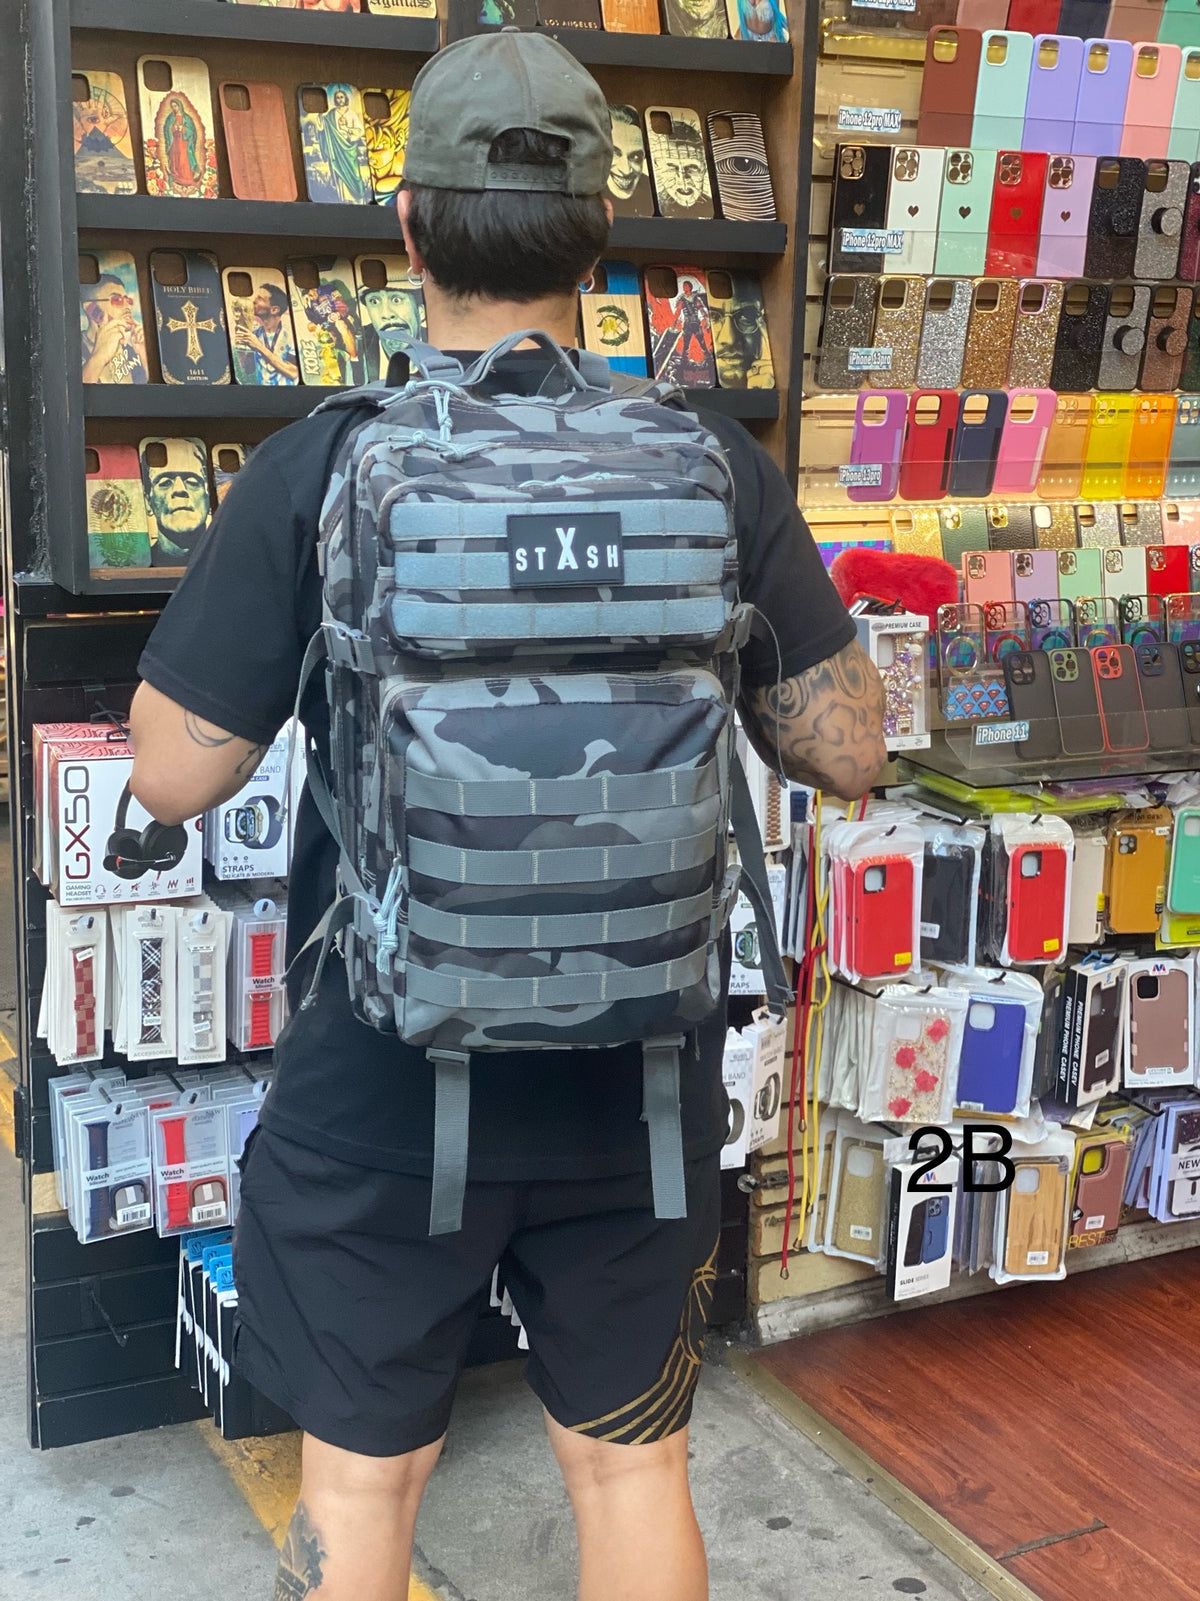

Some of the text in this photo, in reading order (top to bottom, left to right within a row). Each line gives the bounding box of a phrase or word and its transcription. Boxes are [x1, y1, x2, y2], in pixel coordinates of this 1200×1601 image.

[544, 18, 598, 29] LOS ANGELES
[839, 109, 901, 130] iPhone 12pro MAX
[842, 232, 902, 250] iPhone 12pro MAX
[163, 286, 213, 294] HOLY BIBLE
[112, 348, 129, 369] BAD
[301, 340, 320, 376] KOBE
[849, 351, 891, 368] iPhone 13pro
[114, 354, 142, 384] BUNNY
[189, 368, 205, 376] 1611
[839, 466, 882, 484] iPhone 13pro
[885, 622, 908, 630] PREMIUM
[978, 724, 1027, 744] iPhone 11
[260, 765, 281, 774] BAND
[64, 765, 91, 880] GX50
[222, 864, 255, 873] STRAPS
[252, 976, 275, 984] Watch
[1064, 996, 1072, 1029] PREMIUM
[1075, 1000, 1084, 1034] PREMIUM
[1062, 1029, 1070, 1055] PHONE
[1073, 1034, 1082, 1060] PHONE
[133, 1049, 173, 1058] ACCESSORIES
[183, 1053, 222, 1061] ACCESSORIES
[160, 1168, 185, 1177] Watch
[1178, 1158, 1200, 1170] NEW
[86, 1172, 110, 1182] Watch
[1068, 1230, 1105, 1250] BEST
[900, 1277, 914, 1286] SLIDE
